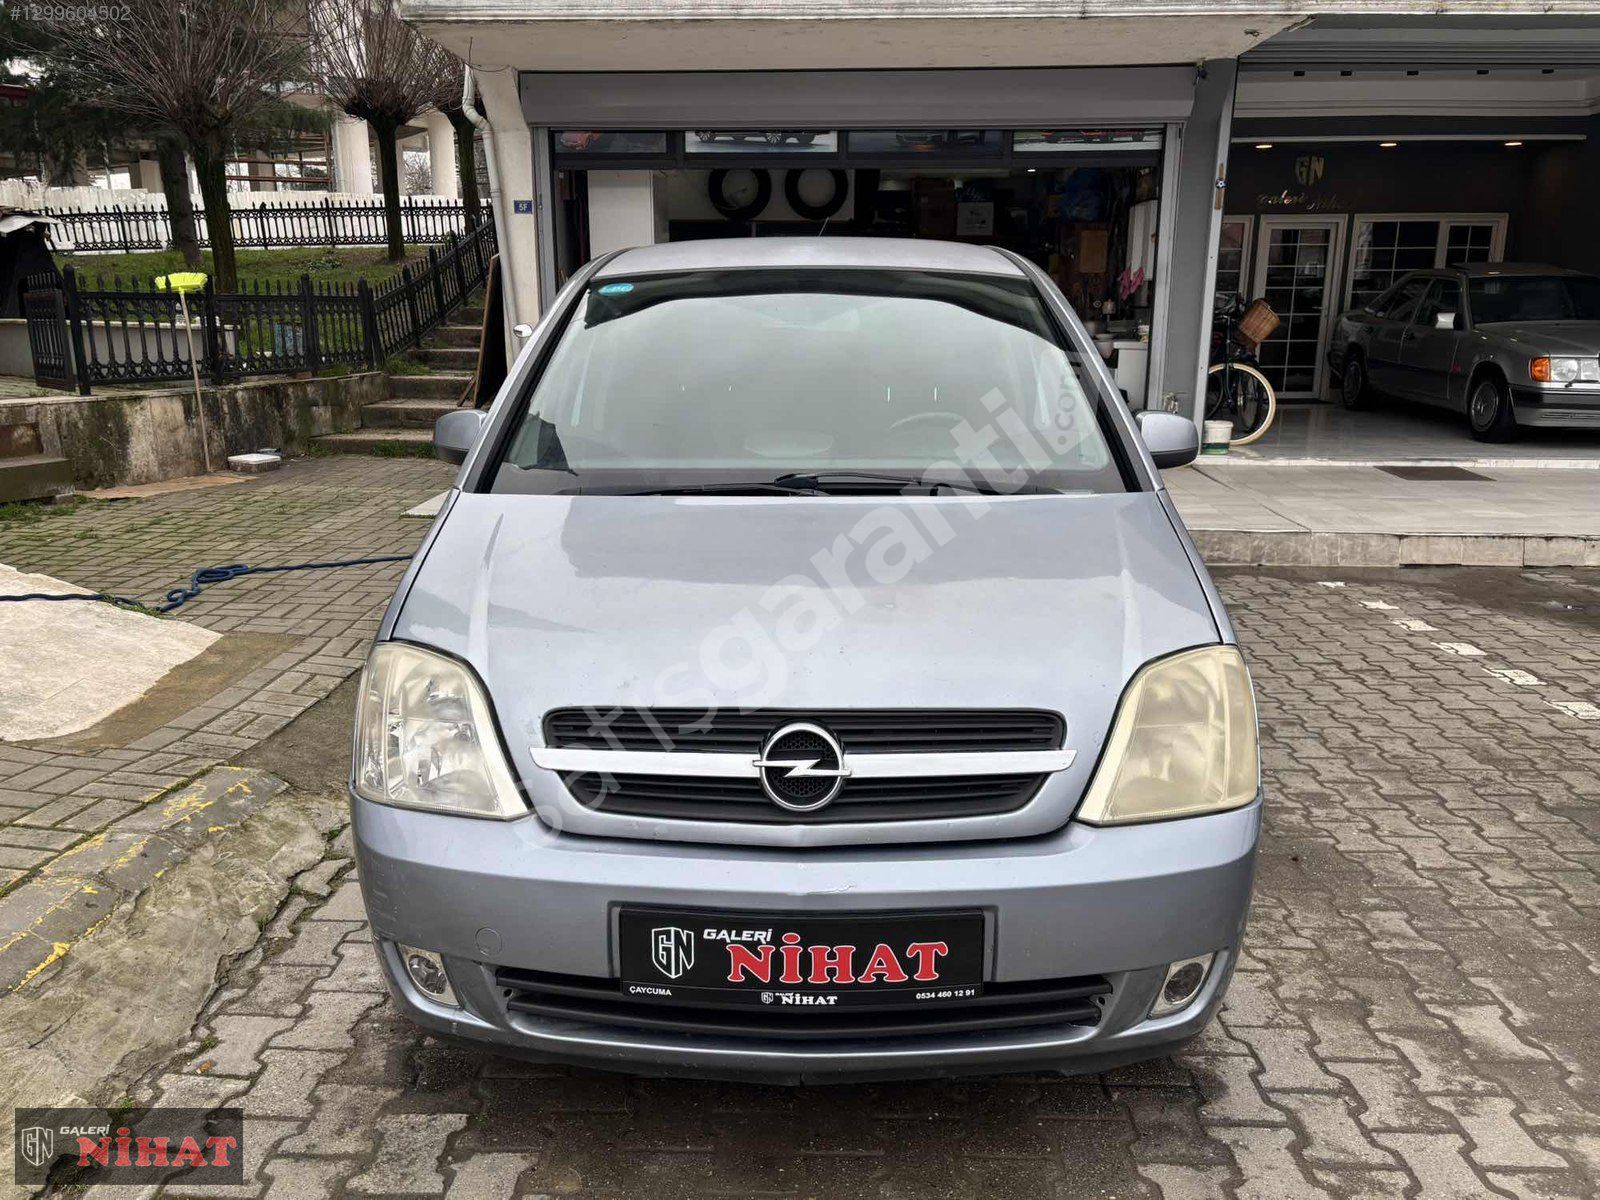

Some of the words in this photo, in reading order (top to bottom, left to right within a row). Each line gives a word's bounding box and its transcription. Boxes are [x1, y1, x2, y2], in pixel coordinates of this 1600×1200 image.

[629, 985, 672, 996] ÇAYCUMA
[915, 991, 936, 1000] 0534
[954, 989, 964, 997] 12
